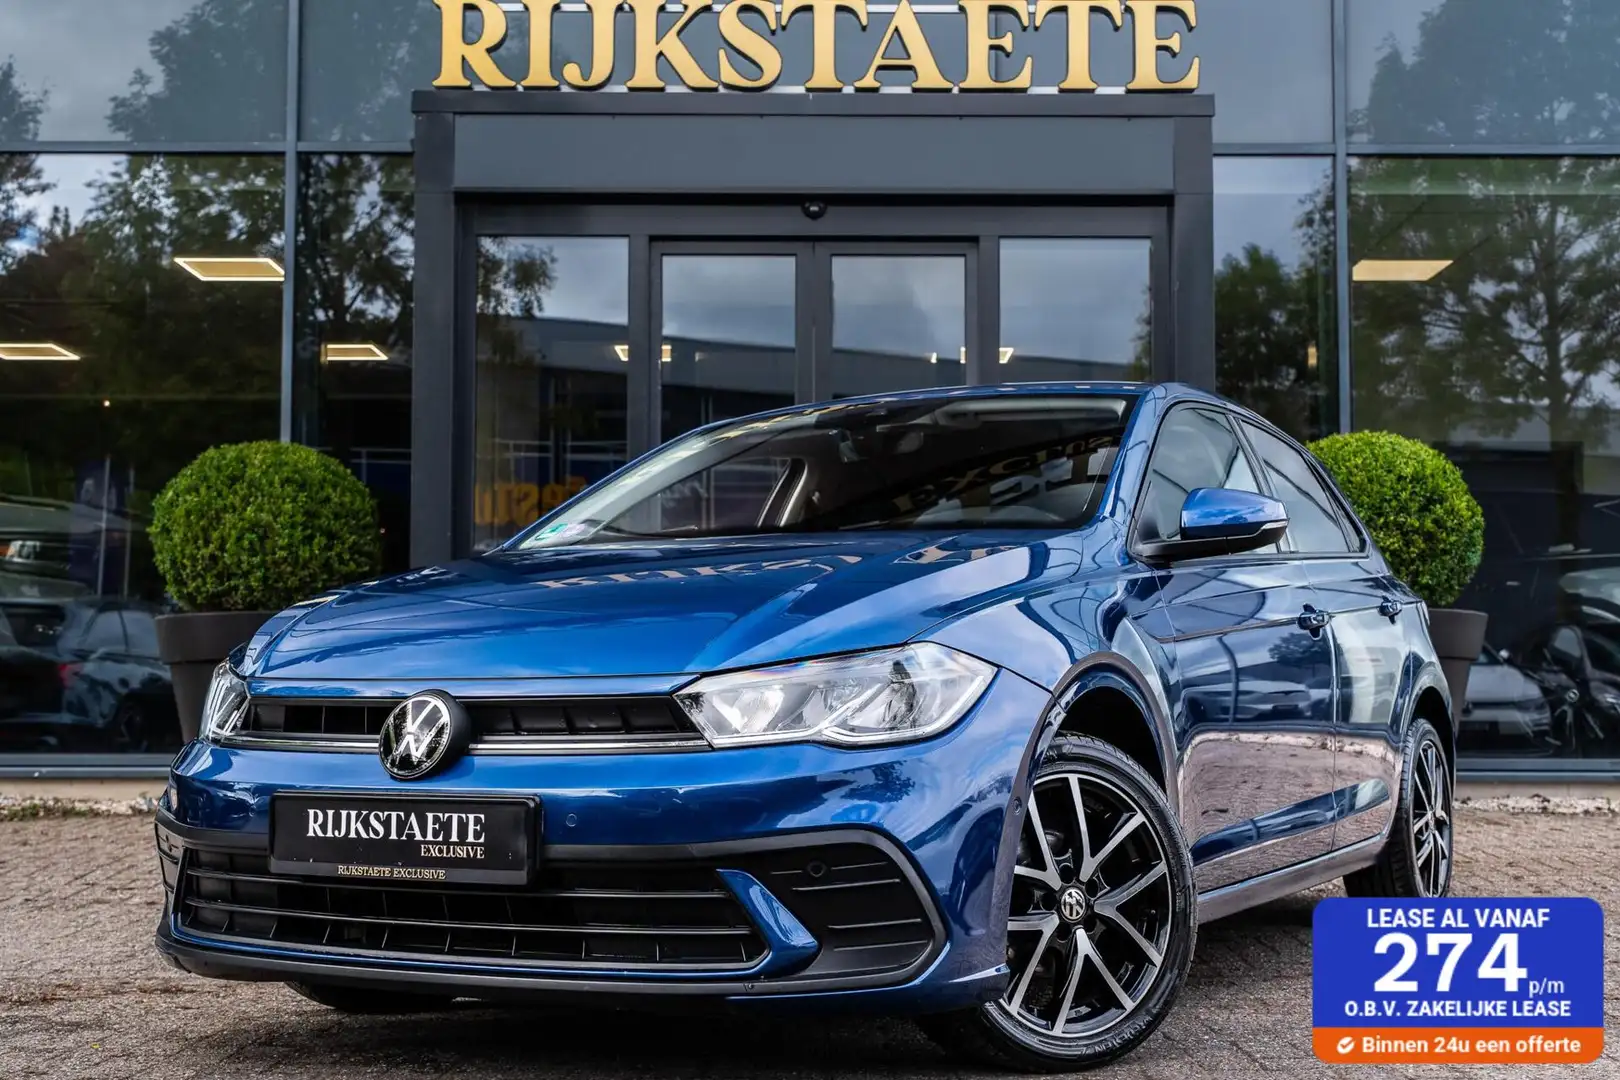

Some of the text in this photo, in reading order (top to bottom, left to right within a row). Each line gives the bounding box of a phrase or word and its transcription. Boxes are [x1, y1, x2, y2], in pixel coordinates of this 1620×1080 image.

[431, 0, 1201, 92] RIJKSTAETE
[306, 808, 485, 843] RIJKSTAETE
[420, 844, 485, 859] EXCLUSIVE
[337, 865, 446, 880] RIJKSTAETE EXCLUSIVE
